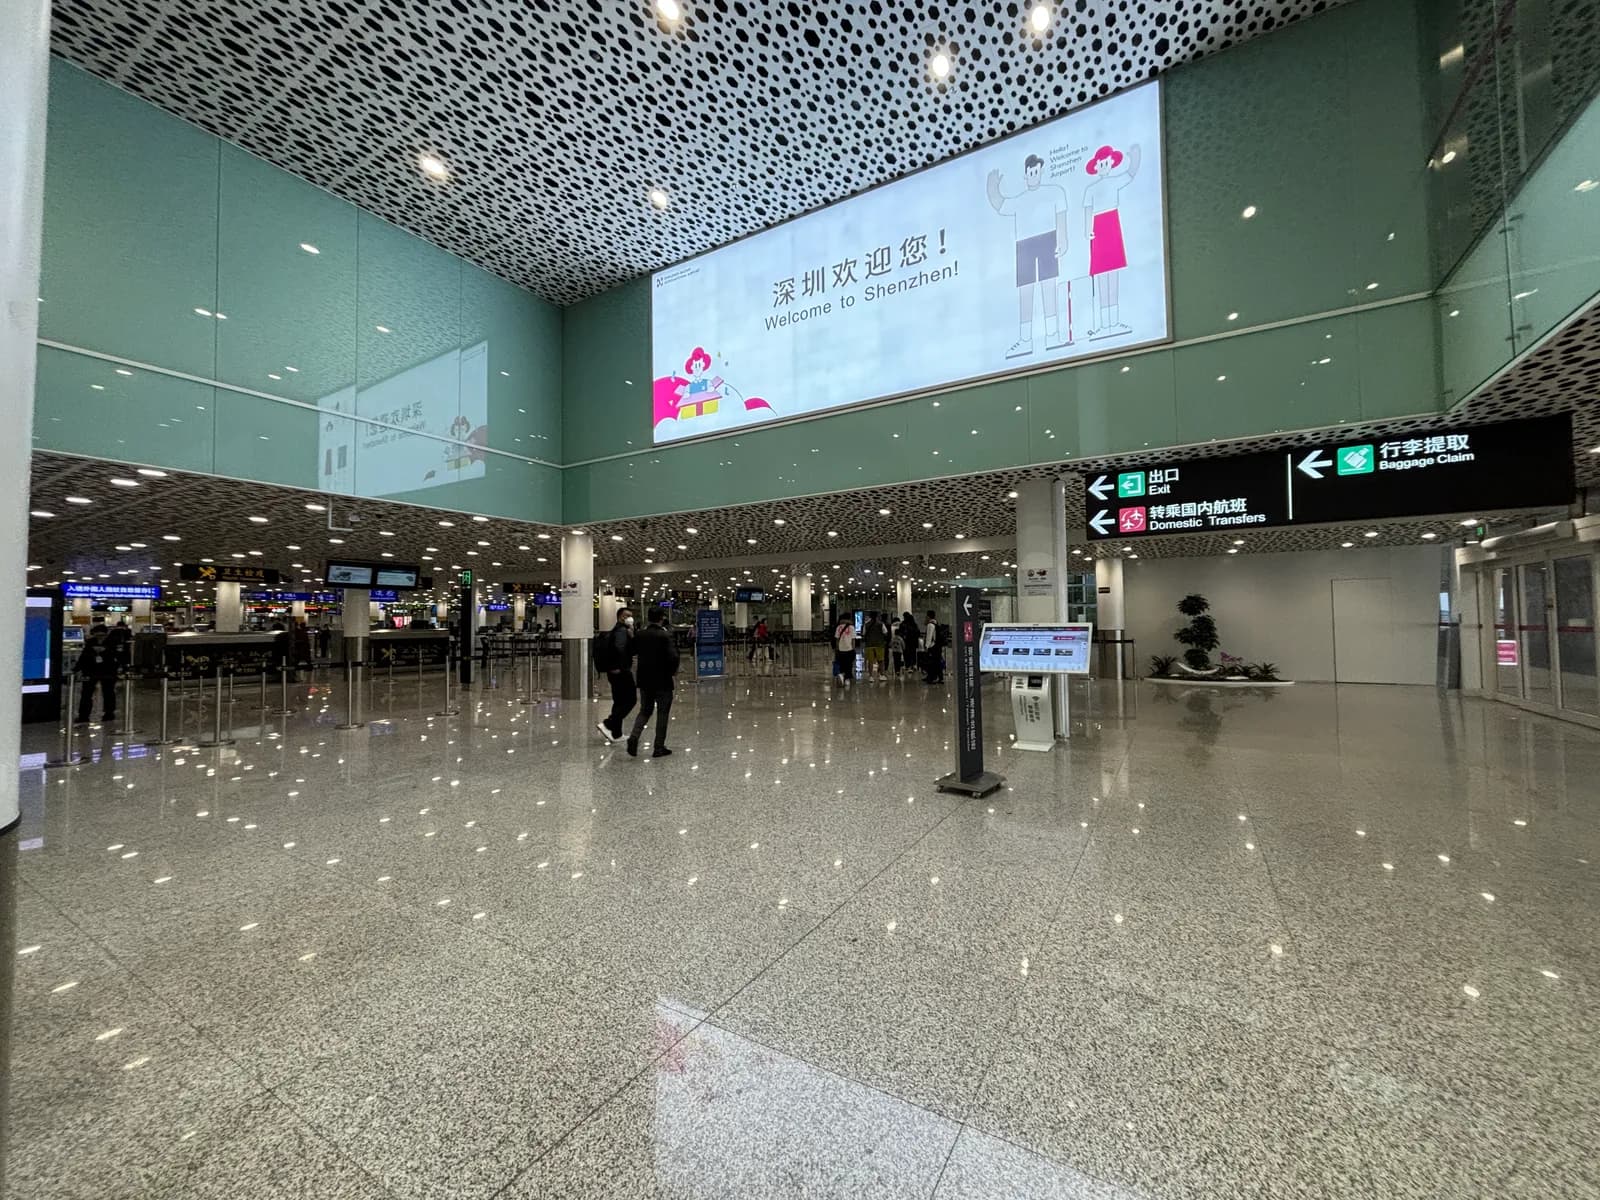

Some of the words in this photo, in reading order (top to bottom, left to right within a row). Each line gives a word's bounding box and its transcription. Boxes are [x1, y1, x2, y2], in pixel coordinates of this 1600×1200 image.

[772, 228, 947, 308] 深圳欢迎您！
[765, 301, 832, 331] Welcome
[840, 295, 855, 309] to
[864, 260, 959, 302] Shenzhen!
[1379, 434, 1470, 459] 行李提取
[1379, 457, 1435, 470] Baggage
[1436, 452, 1475, 464] Claim
[1149, 468, 1180, 484] 出口
[1149, 484, 1171, 496] Exit
[1150, 498, 1247, 519] 转乘国内航班
[1150, 517, 1203, 531] Domestic
[1207, 513, 1266, 527] Transfers
